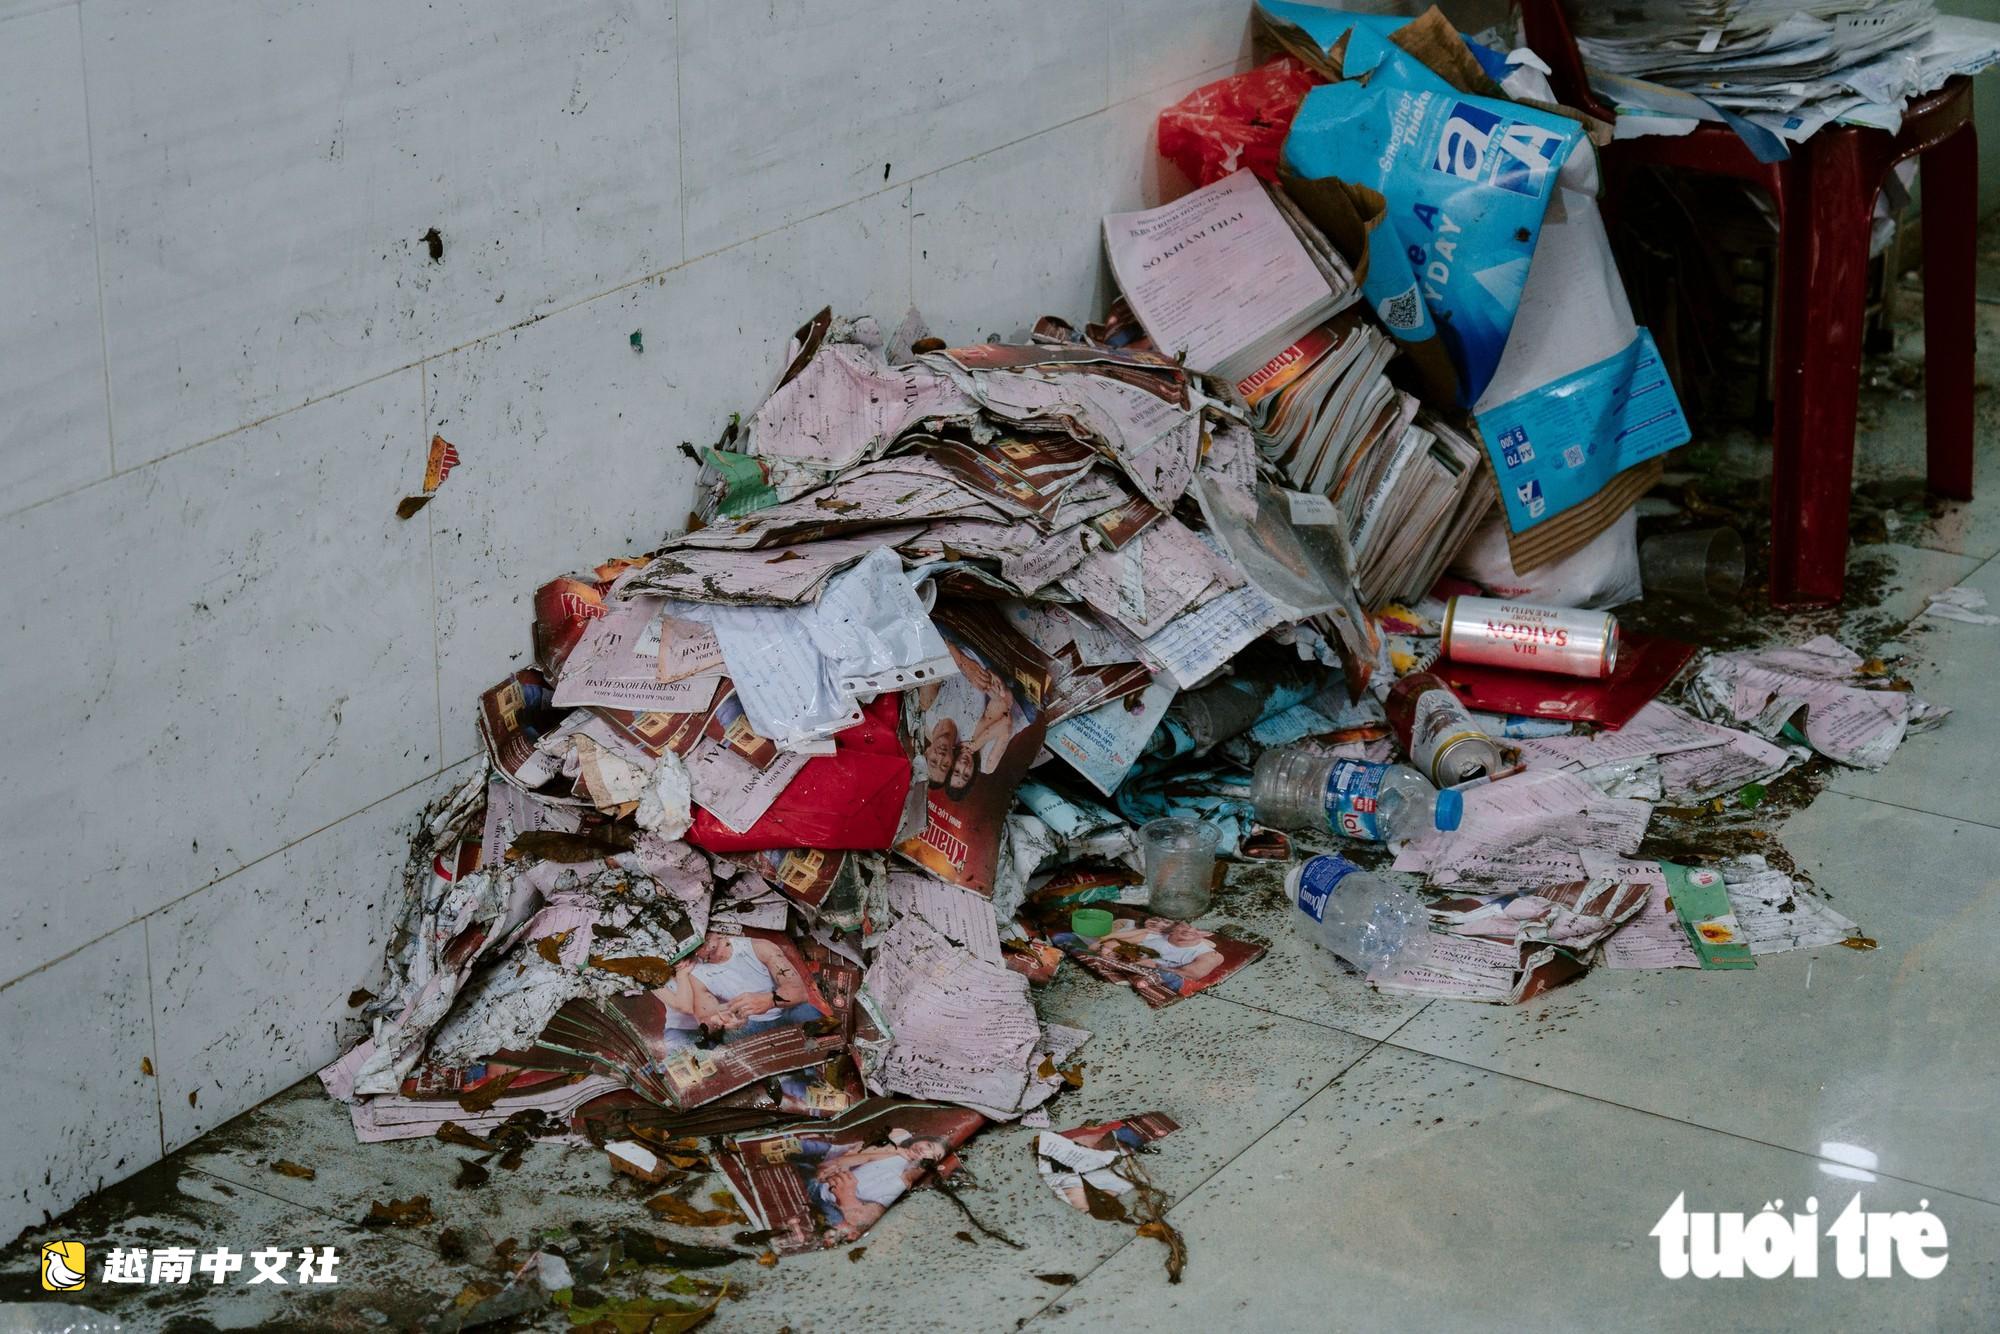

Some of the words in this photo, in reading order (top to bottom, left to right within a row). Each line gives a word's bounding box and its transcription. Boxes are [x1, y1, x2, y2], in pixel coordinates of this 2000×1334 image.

[1378, 90, 1412, 176] Smoother
[1515, 431, 1523, 441] 5
[1507, 454, 1519, 466] 70
[1500, 605, 1558, 618] PREMIUM
[1487, 621, 1568, 646] SAIGON
[1513, 642, 1537, 654] BIA
